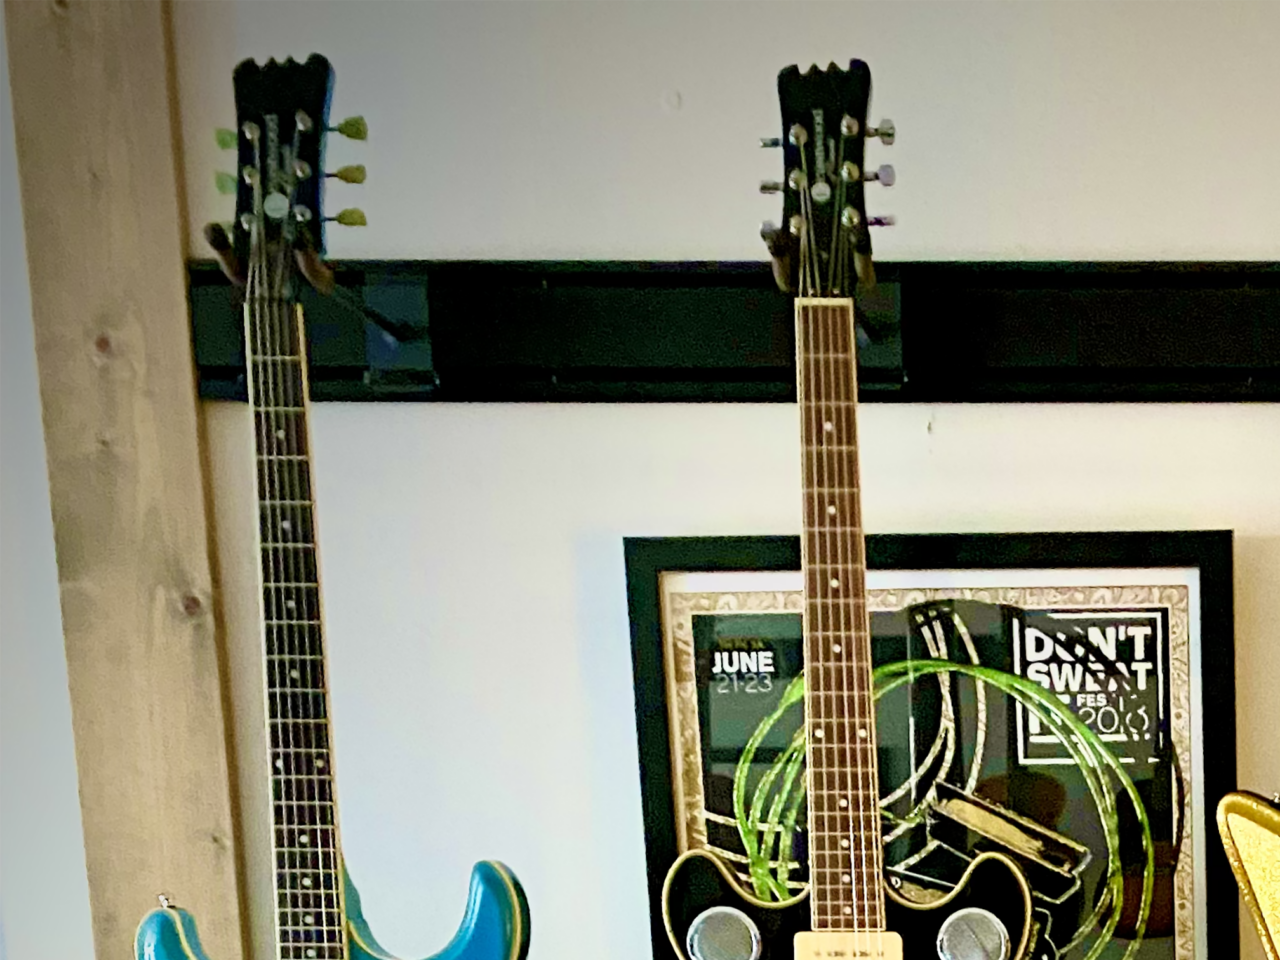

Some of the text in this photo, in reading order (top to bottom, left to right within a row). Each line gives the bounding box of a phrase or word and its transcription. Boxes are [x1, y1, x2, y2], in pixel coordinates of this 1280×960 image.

[1025, 626, 1152, 661] DON'T
[711, 650, 775, 673] JUNE
[1026, 662, 1153, 691] SWEAT
[1076, 693, 1115, 707] FES
